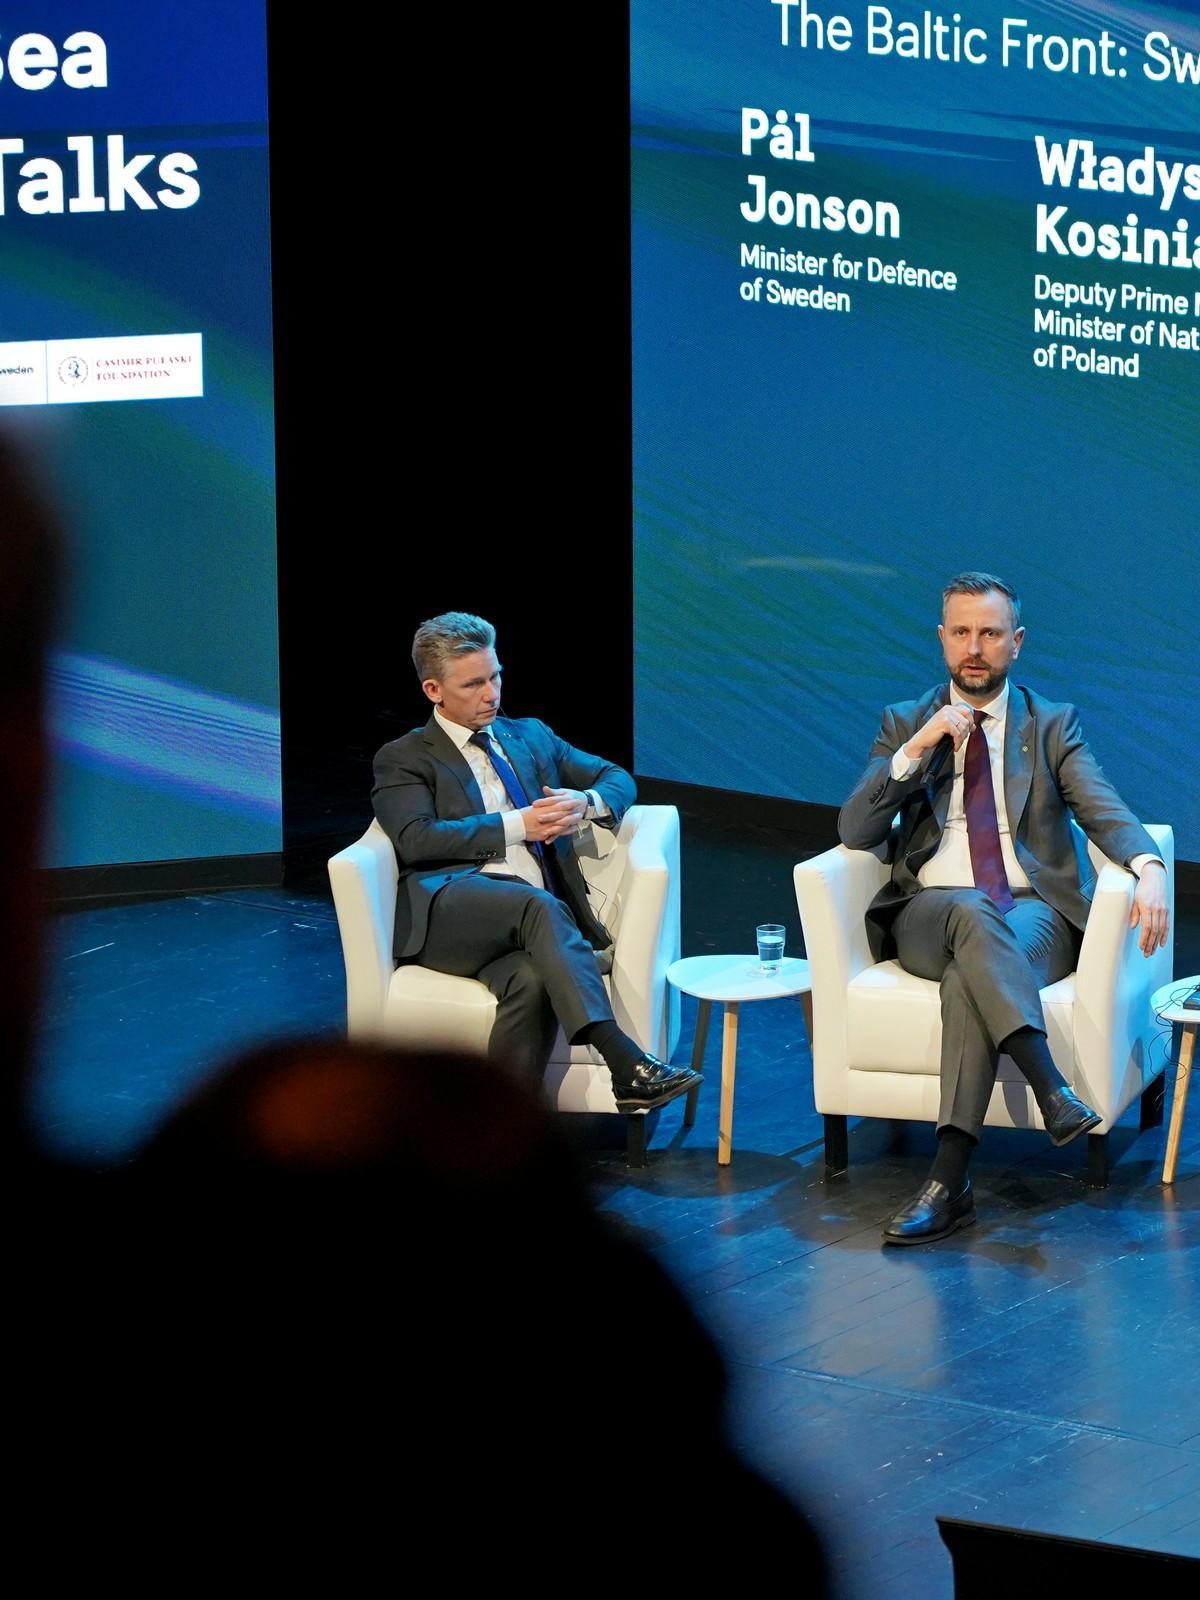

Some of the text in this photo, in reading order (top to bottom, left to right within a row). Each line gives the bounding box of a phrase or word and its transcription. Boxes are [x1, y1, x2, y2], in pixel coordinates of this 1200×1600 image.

[771, 0, 852, 50] The
[867, 6, 988, 64] Baltic
[1002, 18, 1127, 78] Front:
[0, 30, 108, 91] ea
[741, 107, 815, 162] Pål
[739, 174, 900, 239] Jonson
[740, 242, 958, 291] Minister for Defence
[740, 276, 851, 312] of Sweden
[1034, 275, 1117, 313] Deputy
[1121, 283, 1189, 315] Prime
[1034, 307, 1126, 342] Minister
[1129, 319, 1156, 346] of
[0, 365, 34, 375] weden
[96, 358, 142, 368] CASIMIR
[97, 370, 171, 381] FOUNDATION
[1033, 342, 1140, 378] of Poland
